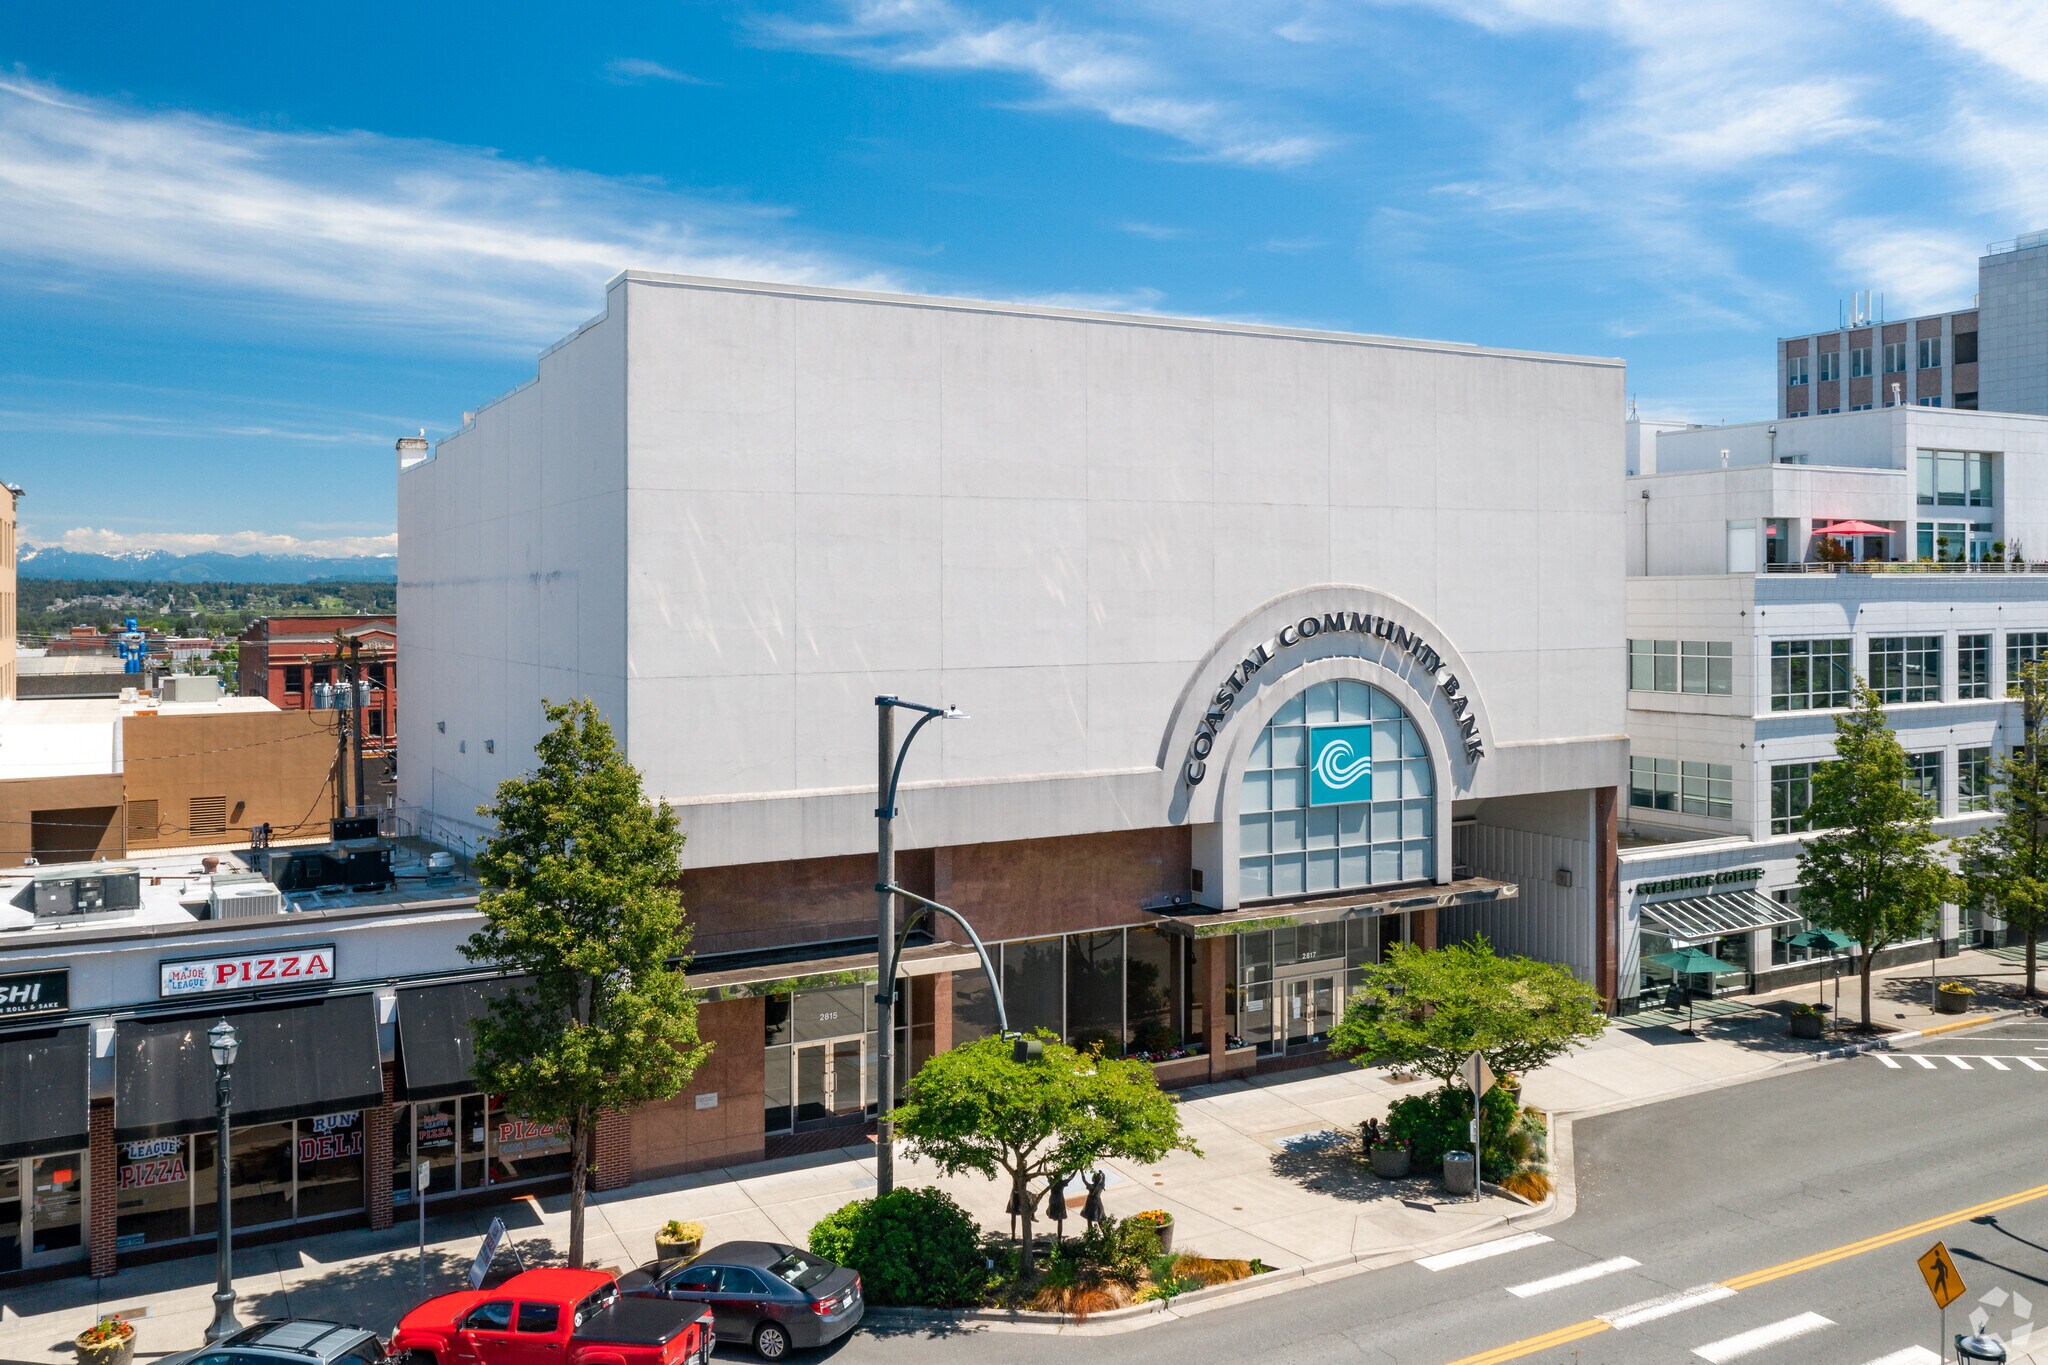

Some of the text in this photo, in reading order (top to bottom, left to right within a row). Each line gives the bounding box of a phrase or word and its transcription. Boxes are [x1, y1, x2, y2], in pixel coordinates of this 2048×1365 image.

[1184, 610, 1486, 787] COASTAL COMMUNITY BANK
[1636, 867, 1763, 896] STARBUCKS COFFEE
[1301, 951, 1317, 960] 2817
[172, 969, 204, 981] MAJOR
[215, 954, 328, 985] PIZZA
[172, 978, 205, 990] LEAGUE
[6, 1005, 27, 1013] ROLL
[38, 1002, 59, 1010] SAKE
[819, 1011, 838, 1021] 2815
[314, 1114, 353, 1131] RUN
[419, 1127, 453, 1140] PIZZA
[130, 1141, 176, 1158] LEAGUE
[300, 1131, 362, 1162] DELI
[121, 1158, 187, 1190] PIZZA
